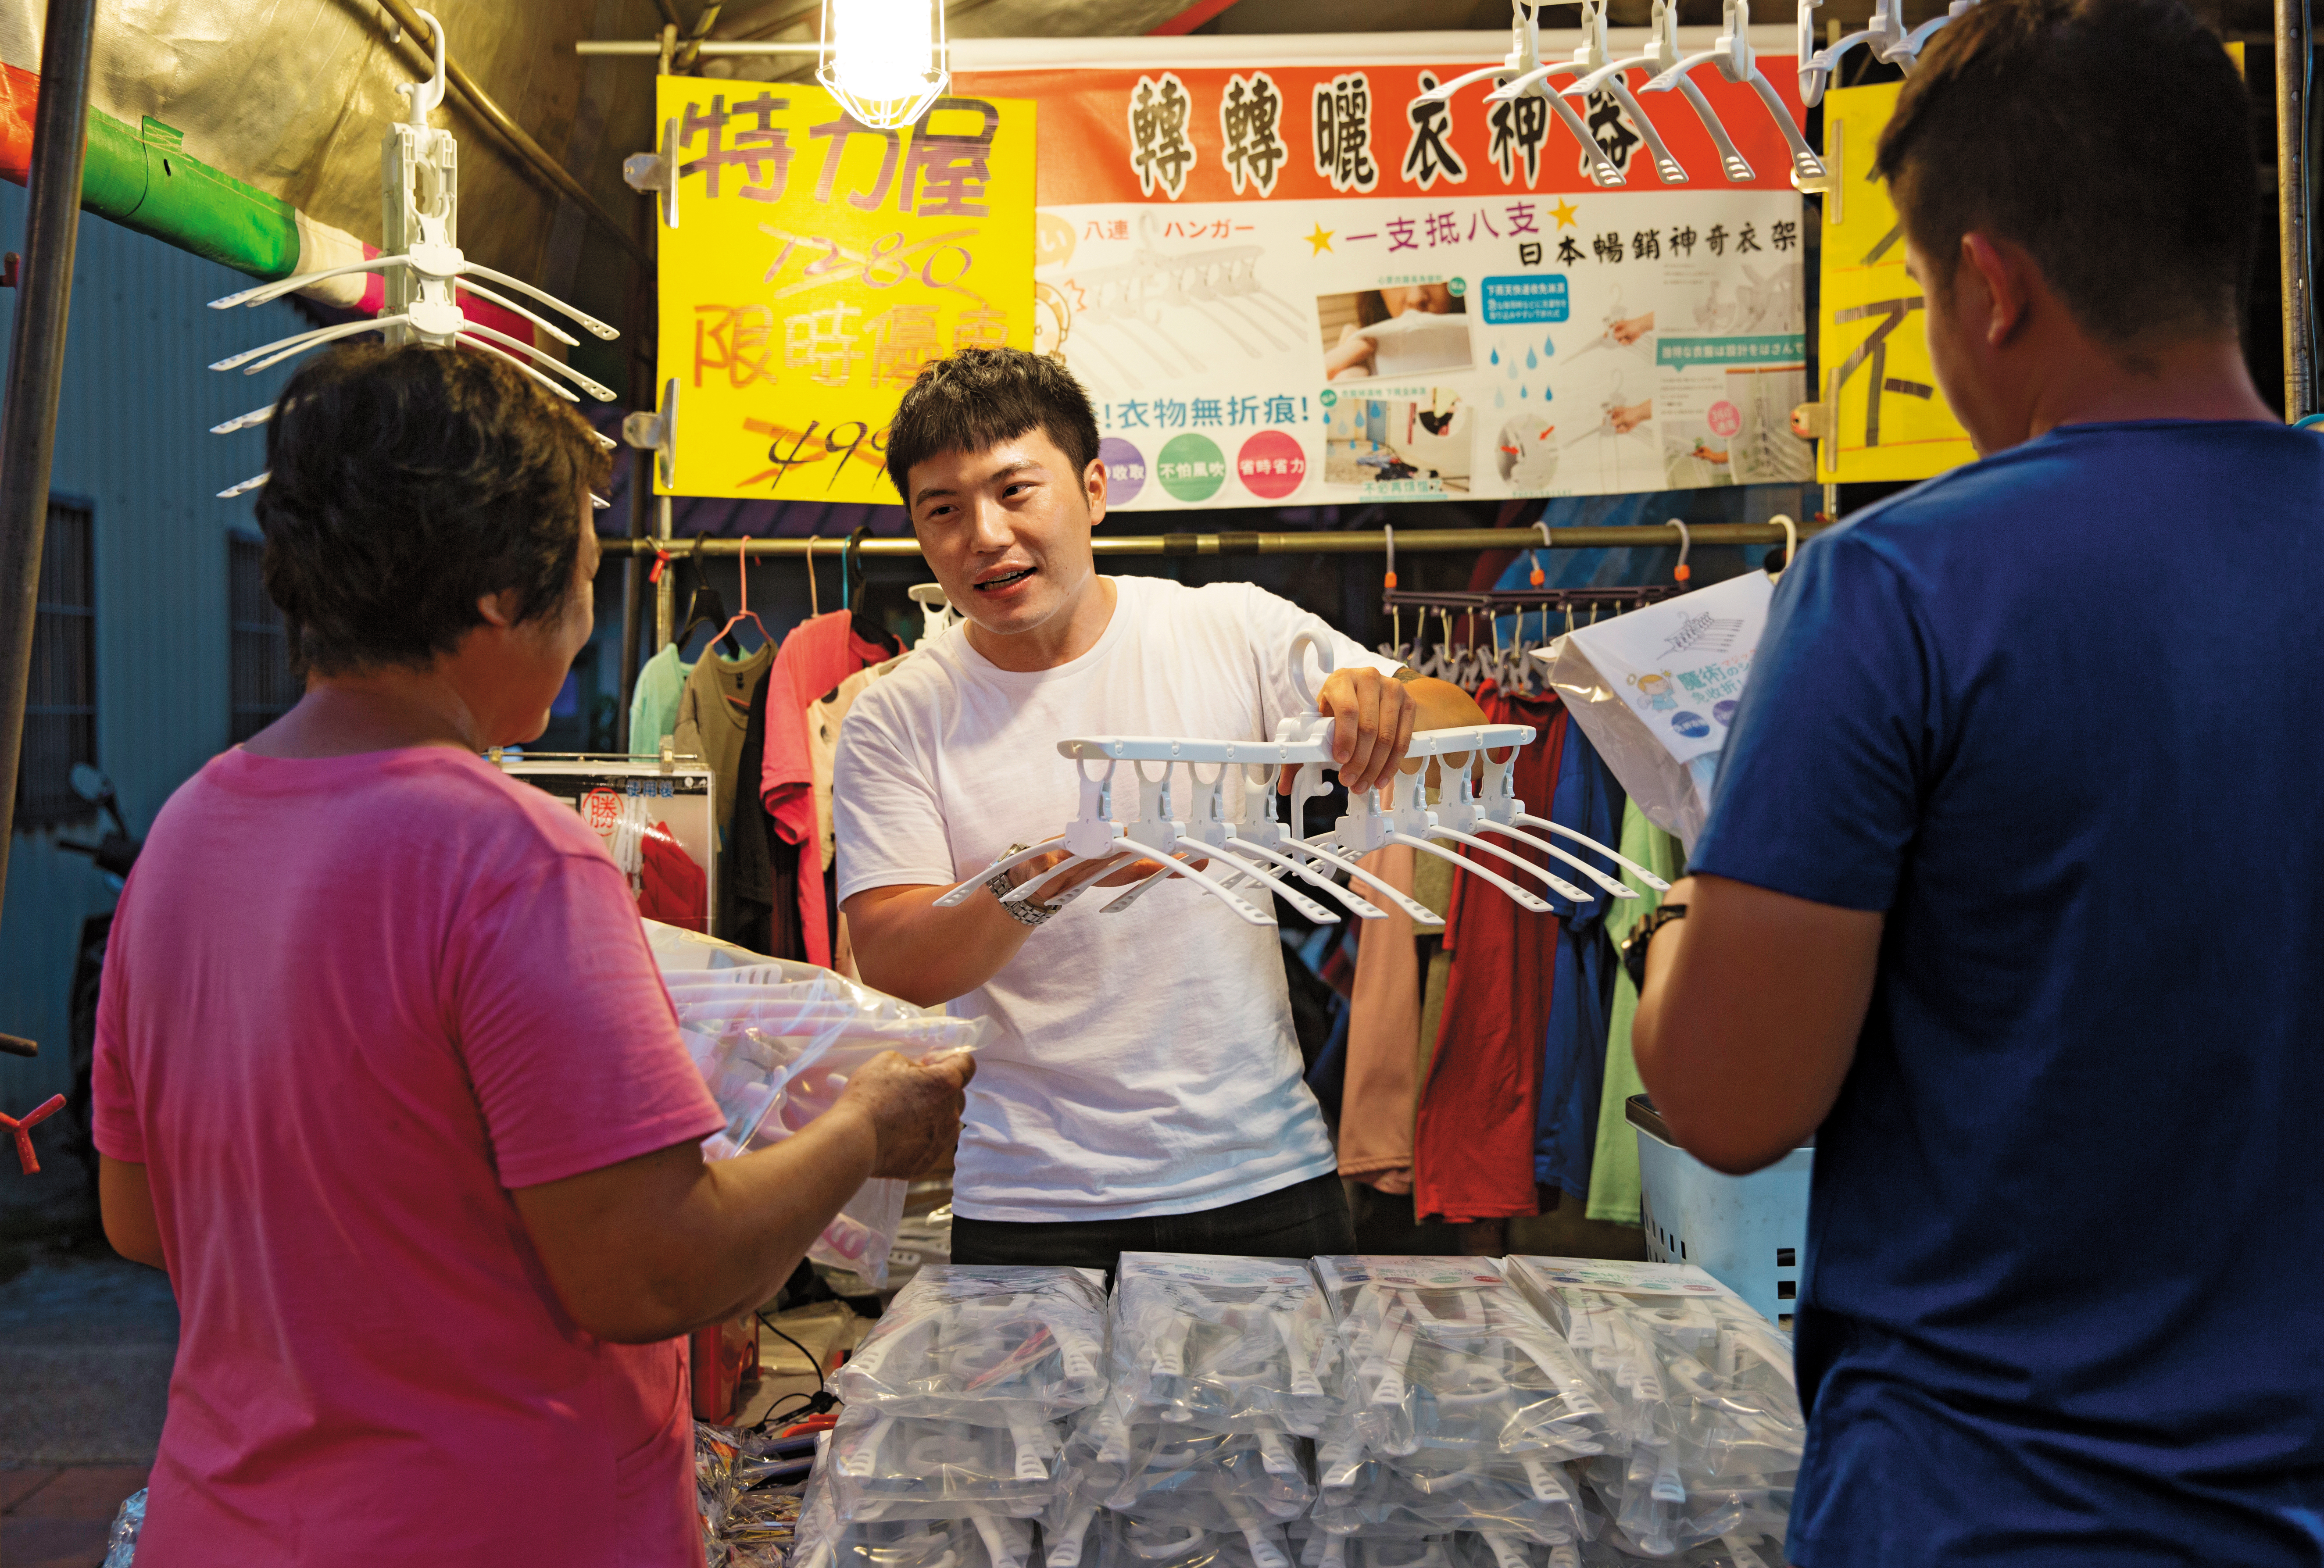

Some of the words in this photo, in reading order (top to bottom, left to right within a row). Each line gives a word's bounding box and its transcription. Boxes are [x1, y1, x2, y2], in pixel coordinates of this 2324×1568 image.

[679, 90, 1000, 218] 特力屋
[1083, 219, 1130, 241] 八連
[1165, 218, 1255, 239] ハンガー
[1345, 201, 1540, 253] 一支抵八支
[1519, 220, 1797, 268] 日本暢銷神奇衣架
[764, 231, 972, 289] 1280
[1092, 394, 1309, 429] !衣物無折痕!
[1239, 458, 1305, 476] 省時省力
[626, 779, 675, 798] 使用後
[590, 795, 617, 829] 勝
